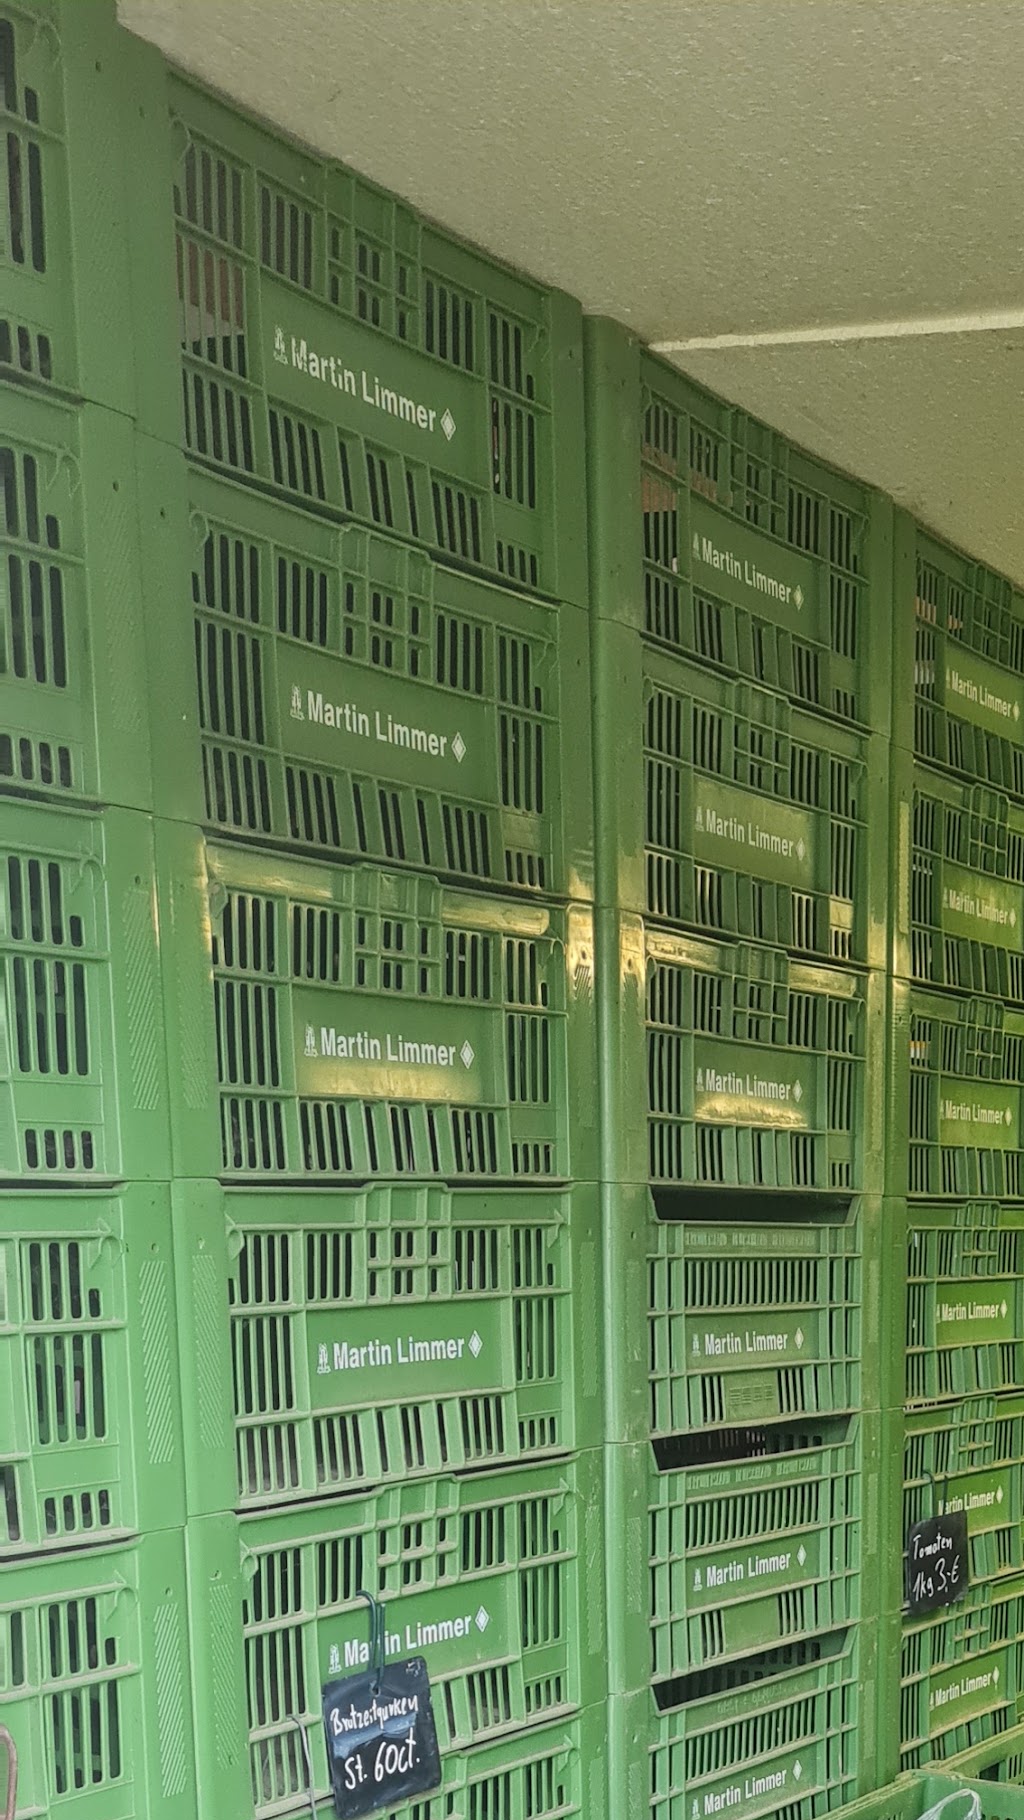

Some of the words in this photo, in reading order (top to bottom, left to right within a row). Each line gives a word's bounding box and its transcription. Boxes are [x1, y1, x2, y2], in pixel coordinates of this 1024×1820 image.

[291, 337, 356, 396] Martin
[362, 370, 436, 432] Limmer
[702, 537, 741, 580] Martin
[745, 560, 791, 603] Limmer
[952, 670, 977, 702] Martin
[980, 685, 1011, 717] Limmer
[307, 690, 370, 737] Martin
[375, 711, 447, 757] Limmer
[706, 808, 745, 843] Martin
[748, 822, 793, 857] Limmer
[949, 889, 974, 915] Martin
[976, 898, 1008, 924] Limmer
[320, 1027, 381, 1060] Martin
[387, 1034, 456, 1066] Limmer
[706, 1069, 743, 1094] Martin
[746, 1074, 790, 1100] Limmer
[945, 1100, 971, 1121] Martin
[972, 1103, 1004, 1124] Limmer
[942, 1302, 967, 1321] Martin
[968, 1301, 999, 1319] Limmer
[333, 1339, 392, 1370] Martin
[397, 1336, 464, 1364] Limmer
[705, 1332, 742, 1355] Martin
[745, 1330, 788, 1351] Limmer
[964, 1491, 995, 1510] Limmer
[913, 1532, 952, 1560] Tomaten
[706, 1561, 743, 1588] Martin
[748, 1552, 791, 1577] Limmer
[912, 1571, 934, 1601] 1kg
[344, 1630, 401, 1667] Main
[406, 1615, 471, 1649] Limmer
[935, 1683, 959, 1707] Martin
[961, 1672, 991, 1695] Limmer
[345, 1754, 368, 1789] St.
[704, 1785, 741, 1815] Martin
[745, 1769, 787, 1799] Limmer
